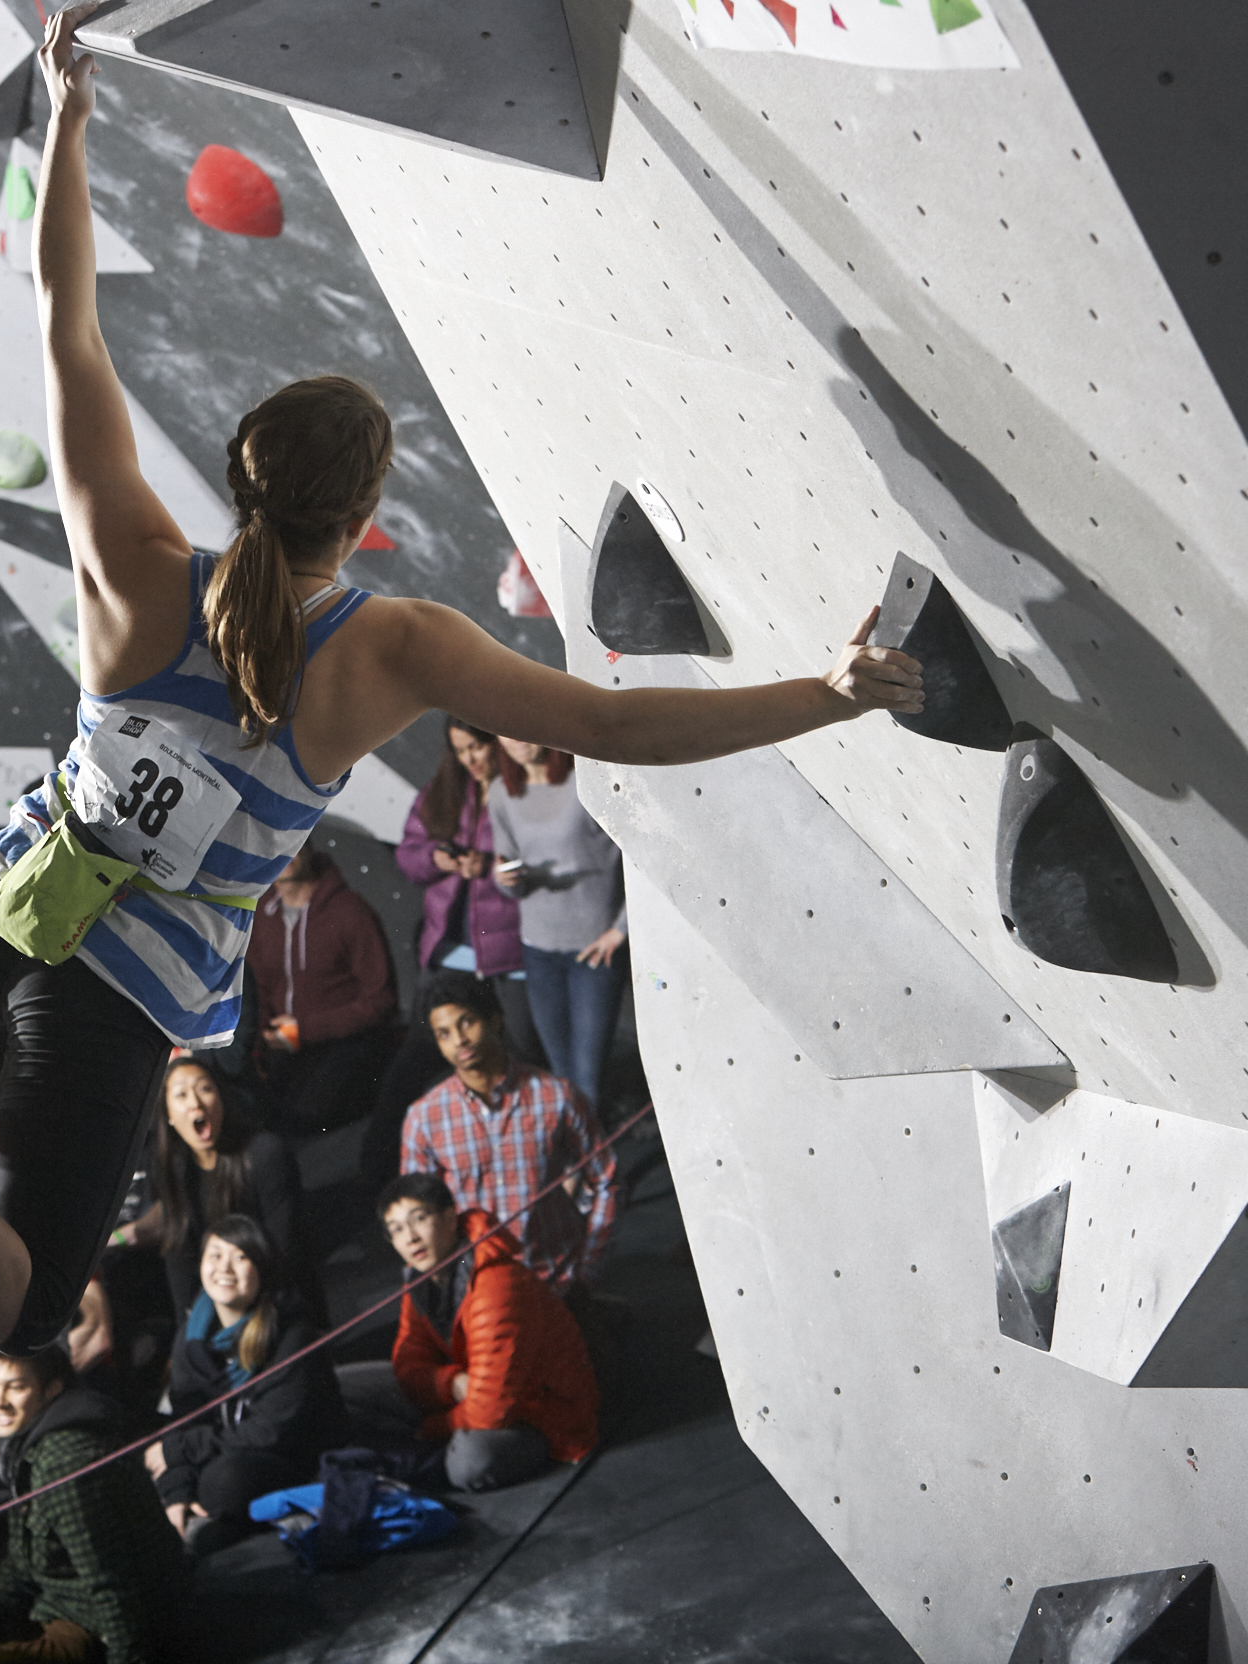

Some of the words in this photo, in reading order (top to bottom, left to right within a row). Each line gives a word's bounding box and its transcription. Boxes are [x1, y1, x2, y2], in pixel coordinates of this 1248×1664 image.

[645, 502, 674, 521] BONUS
[122, 725, 143, 736] SHOP
[126, 719, 147, 732] BLOC
[159, 743, 193, 770] BOULDERING
[192, 766, 221, 791] MONTRÉAL
[115, 757, 184, 838] 38
